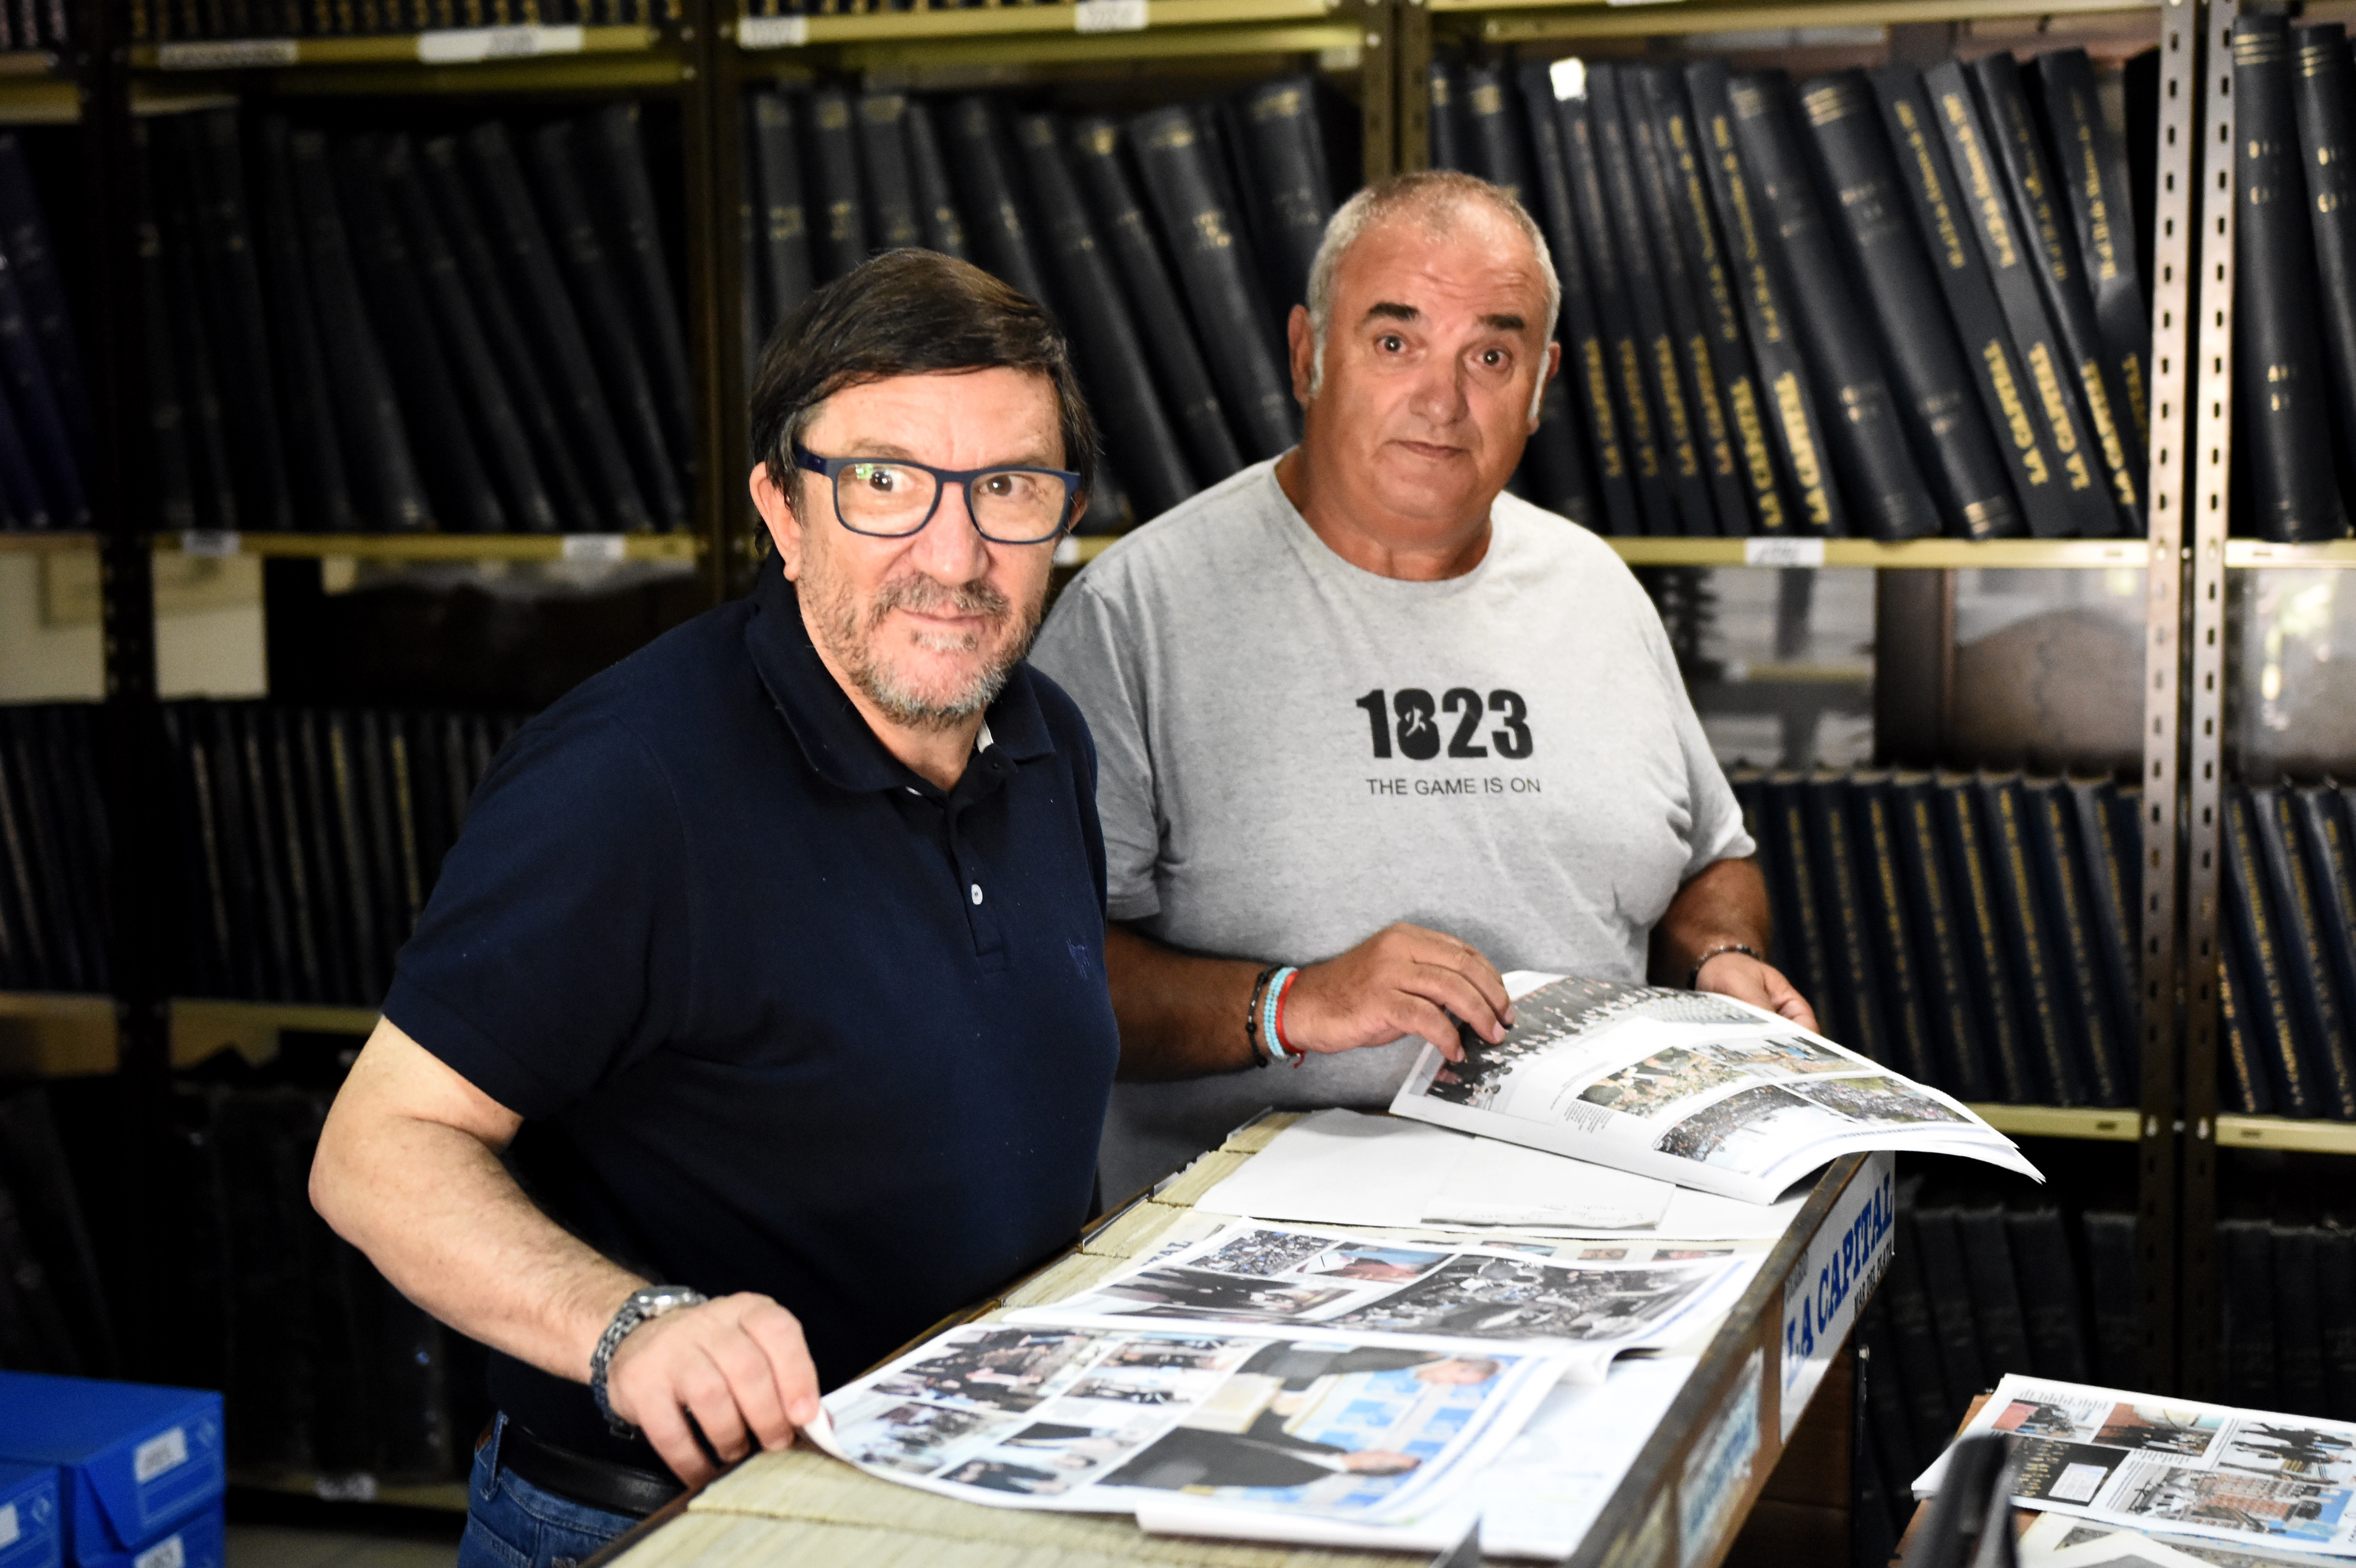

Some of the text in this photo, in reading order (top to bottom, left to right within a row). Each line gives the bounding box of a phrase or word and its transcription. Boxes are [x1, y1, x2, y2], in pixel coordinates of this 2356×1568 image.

[1983, 339, 2049, 486] LA CAPITAL
[2028, 341, 2091, 491] LA CAPITAL
[1355, 687, 1533, 760] 1823
[1366, 778, 1541, 795] THE GAME IS ON
[1787, 1295, 1814, 1391] LA
[1817, 1172, 1893, 1334] CAPITAL
